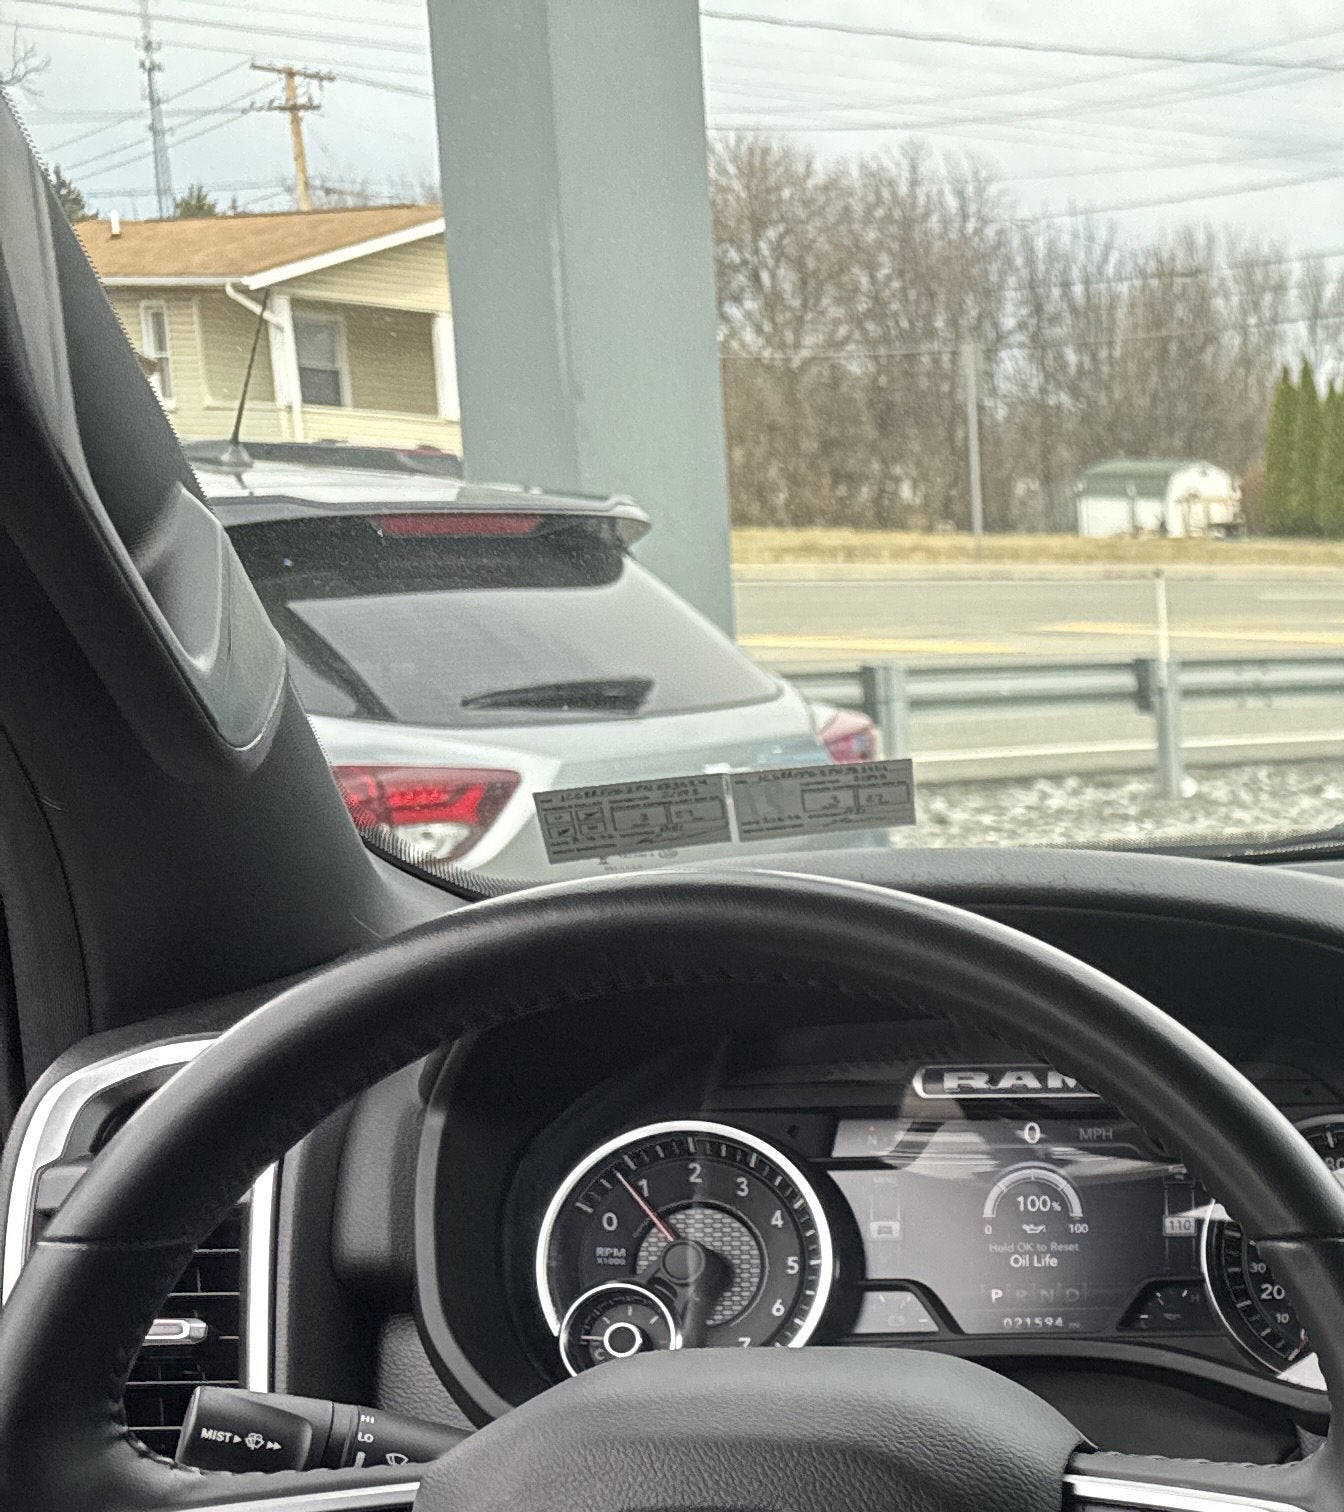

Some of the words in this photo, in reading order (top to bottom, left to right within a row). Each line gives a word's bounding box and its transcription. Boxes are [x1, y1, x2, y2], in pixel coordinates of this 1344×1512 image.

[1023, 1122, 1042, 1144] 0
[1079, 1128, 1113, 1140] MPH
[688, 1163, 703, 1183] 2
[637, 1178, 649, 1197] 1
[736, 1177, 749, 1197] 3
[1016, 1195, 1062, 1212] 100%
[602, 1212, 618, 1231] 0
[770, 1210, 784, 1229] 4
[1169, 1219, 1192, 1231] 110
[984, 1225, 993, 1235] 0
[1069, 1223, 1089, 1234] 100
[596, 1247, 627, 1257] RPM
[989, 1243, 1015, 1253] Hold
[1017, 1243, 1034, 1252] OK
[1036, 1243, 1048, 1252] to
[1050, 1242, 1080, 1252] Reset
[786, 1256, 800, 1275] 5
[1010, 1254, 1030, 1267] Oil
[1034, 1254, 1059, 1267] Life
[1249, 1262, 1266, 1273] 30
[991, 1289, 1003, 1302] P
[1260, 1283, 1286, 1300] 20
[771, 1298, 785, 1317] 6
[1003, 1317, 1063, 1328] 021594
[1275, 1313, 1290, 1324] 10
[360, 1414, 375, 1424] HI
[200, 1427, 233, 1444] MIST
[357, 1431, 374, 1443] LO
